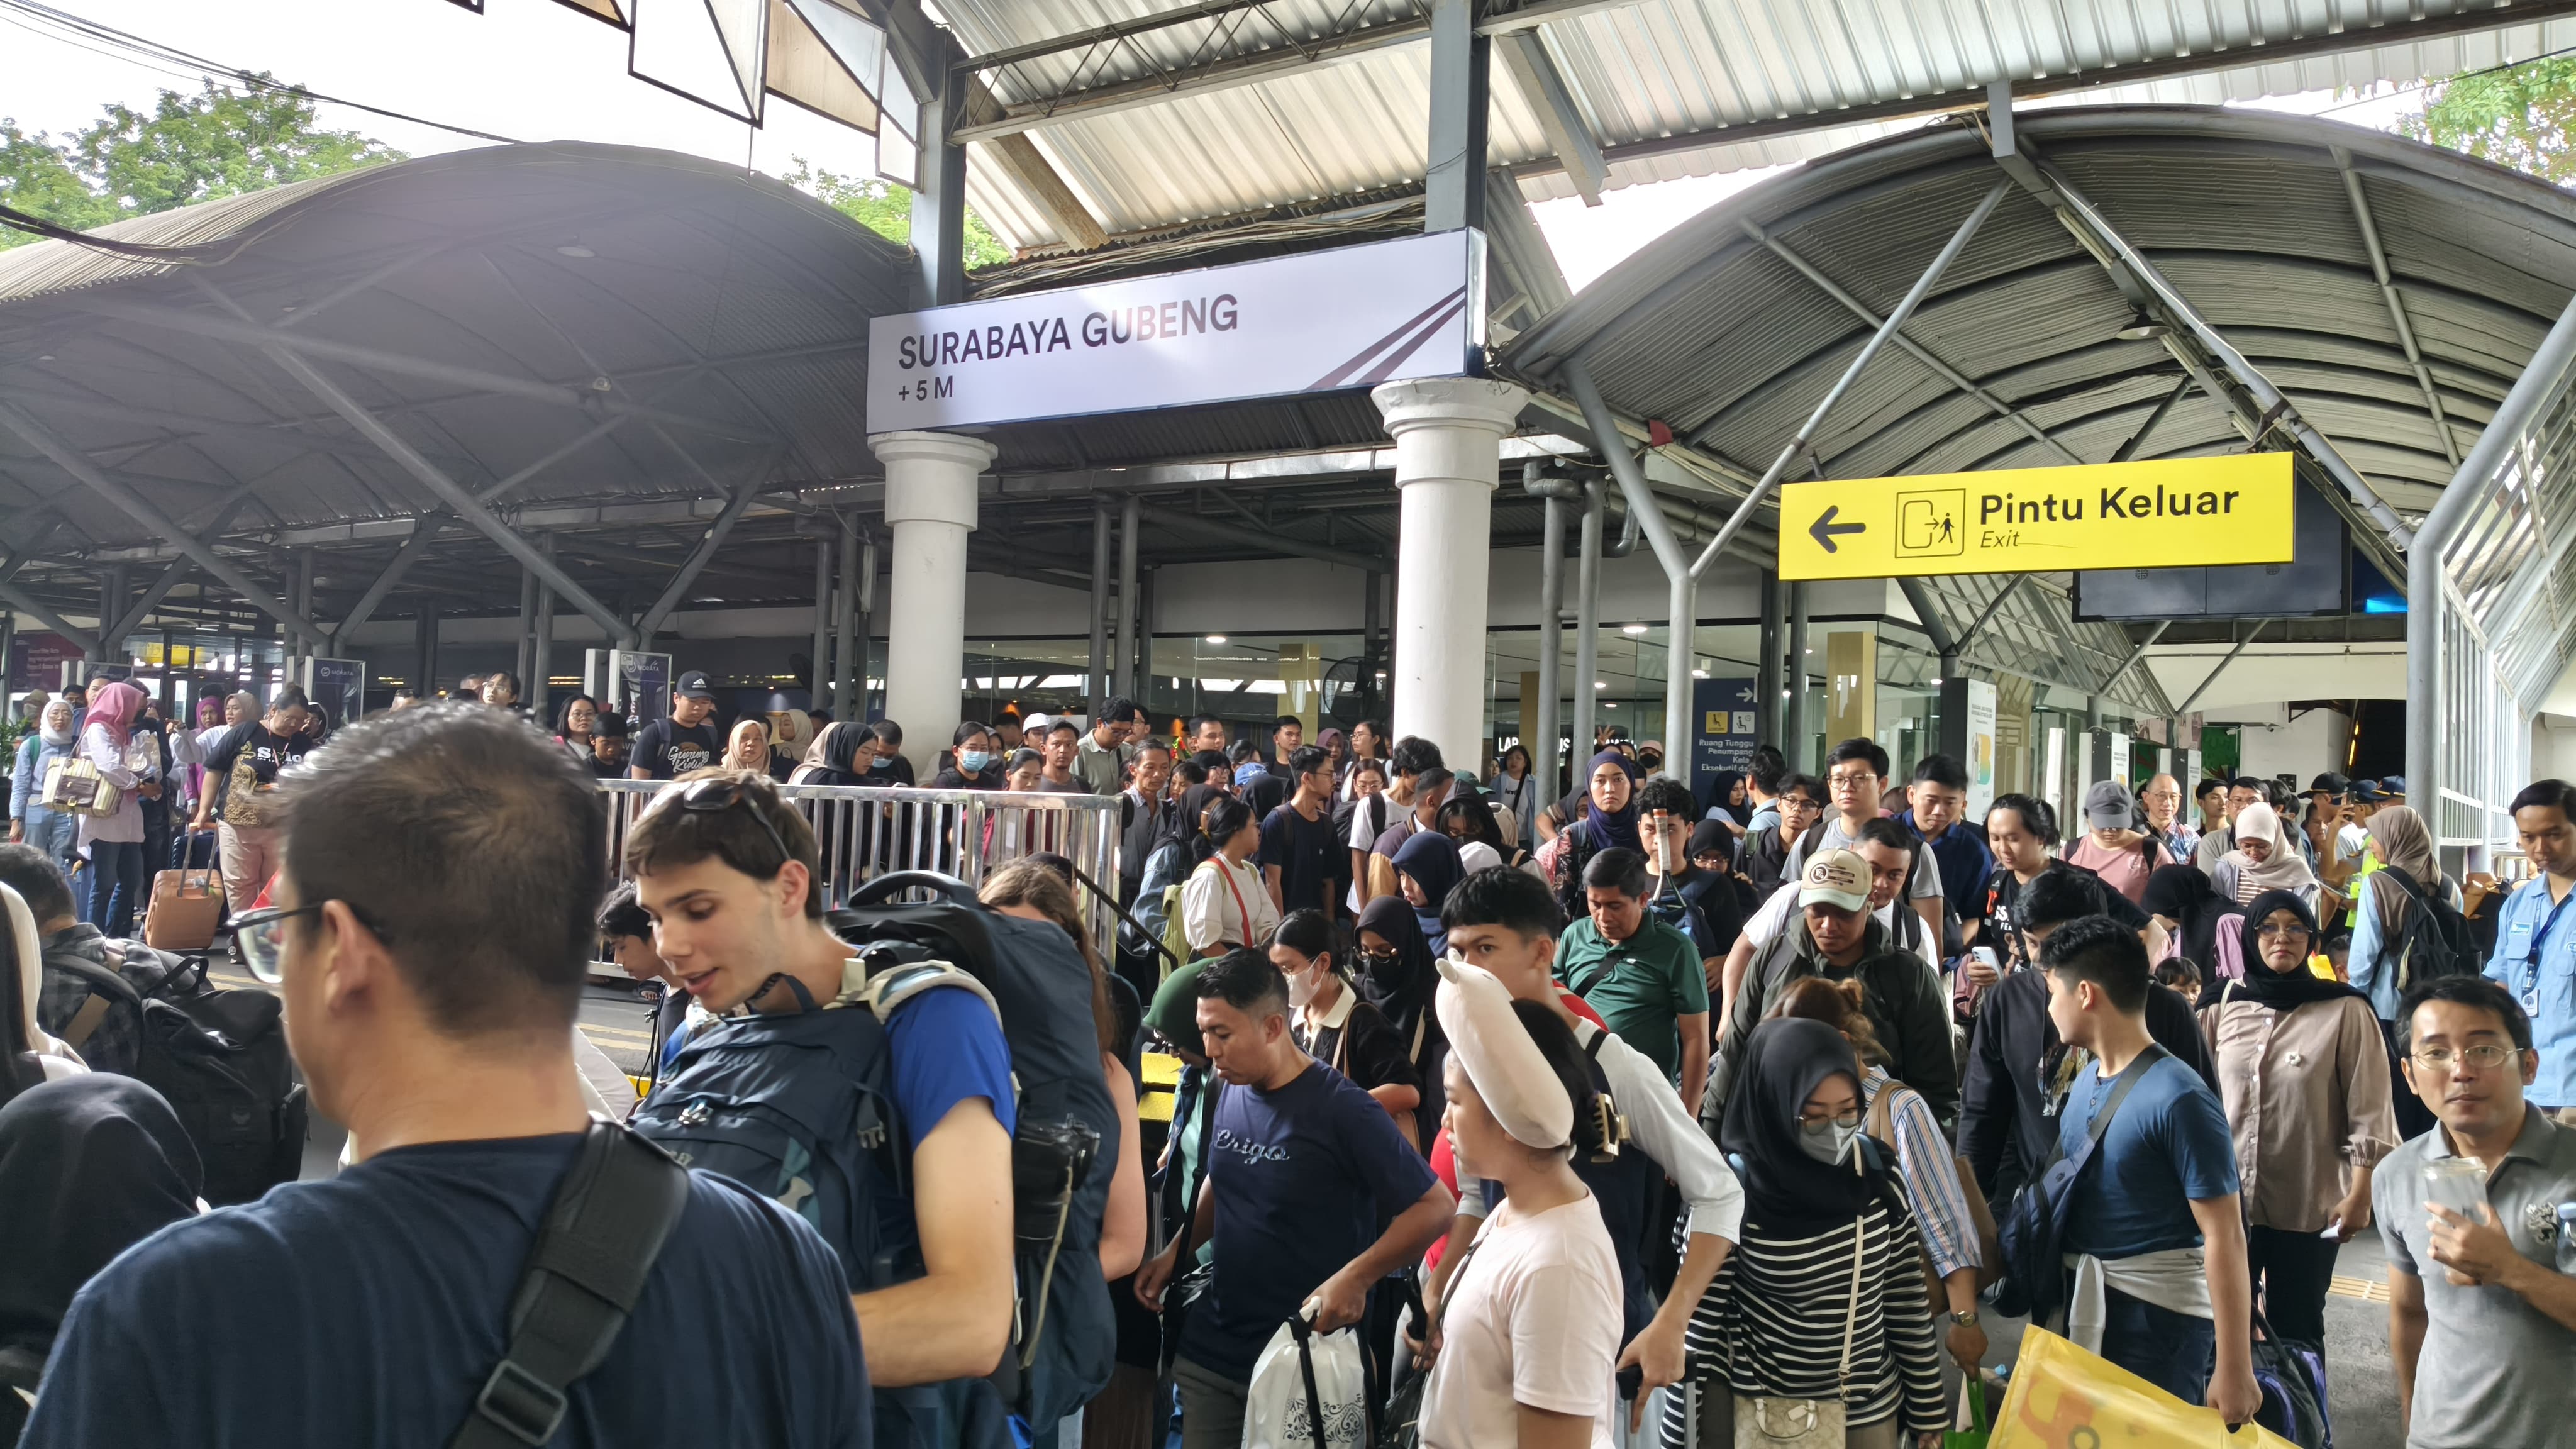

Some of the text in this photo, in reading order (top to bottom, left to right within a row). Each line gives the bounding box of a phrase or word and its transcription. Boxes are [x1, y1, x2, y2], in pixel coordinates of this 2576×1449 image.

[898, 293, 1238, 370] SURABAYA GUBENG
[916, 380, 928, 401] 5
[934, 375, 953, 399] M
[1980, 484, 2240, 525] Pintu Keluar
[1980, 529, 2020, 548] Exit
[1698, 738, 1754, 748] Ruang Tunggu
[1707, 748, 1754, 757] Penumpang
[1701, 763, 1748, 772] Eksekutif da
[1732, 756, 1750, 764] Kela
[1213, 1128, 1291, 1165] Erigo
